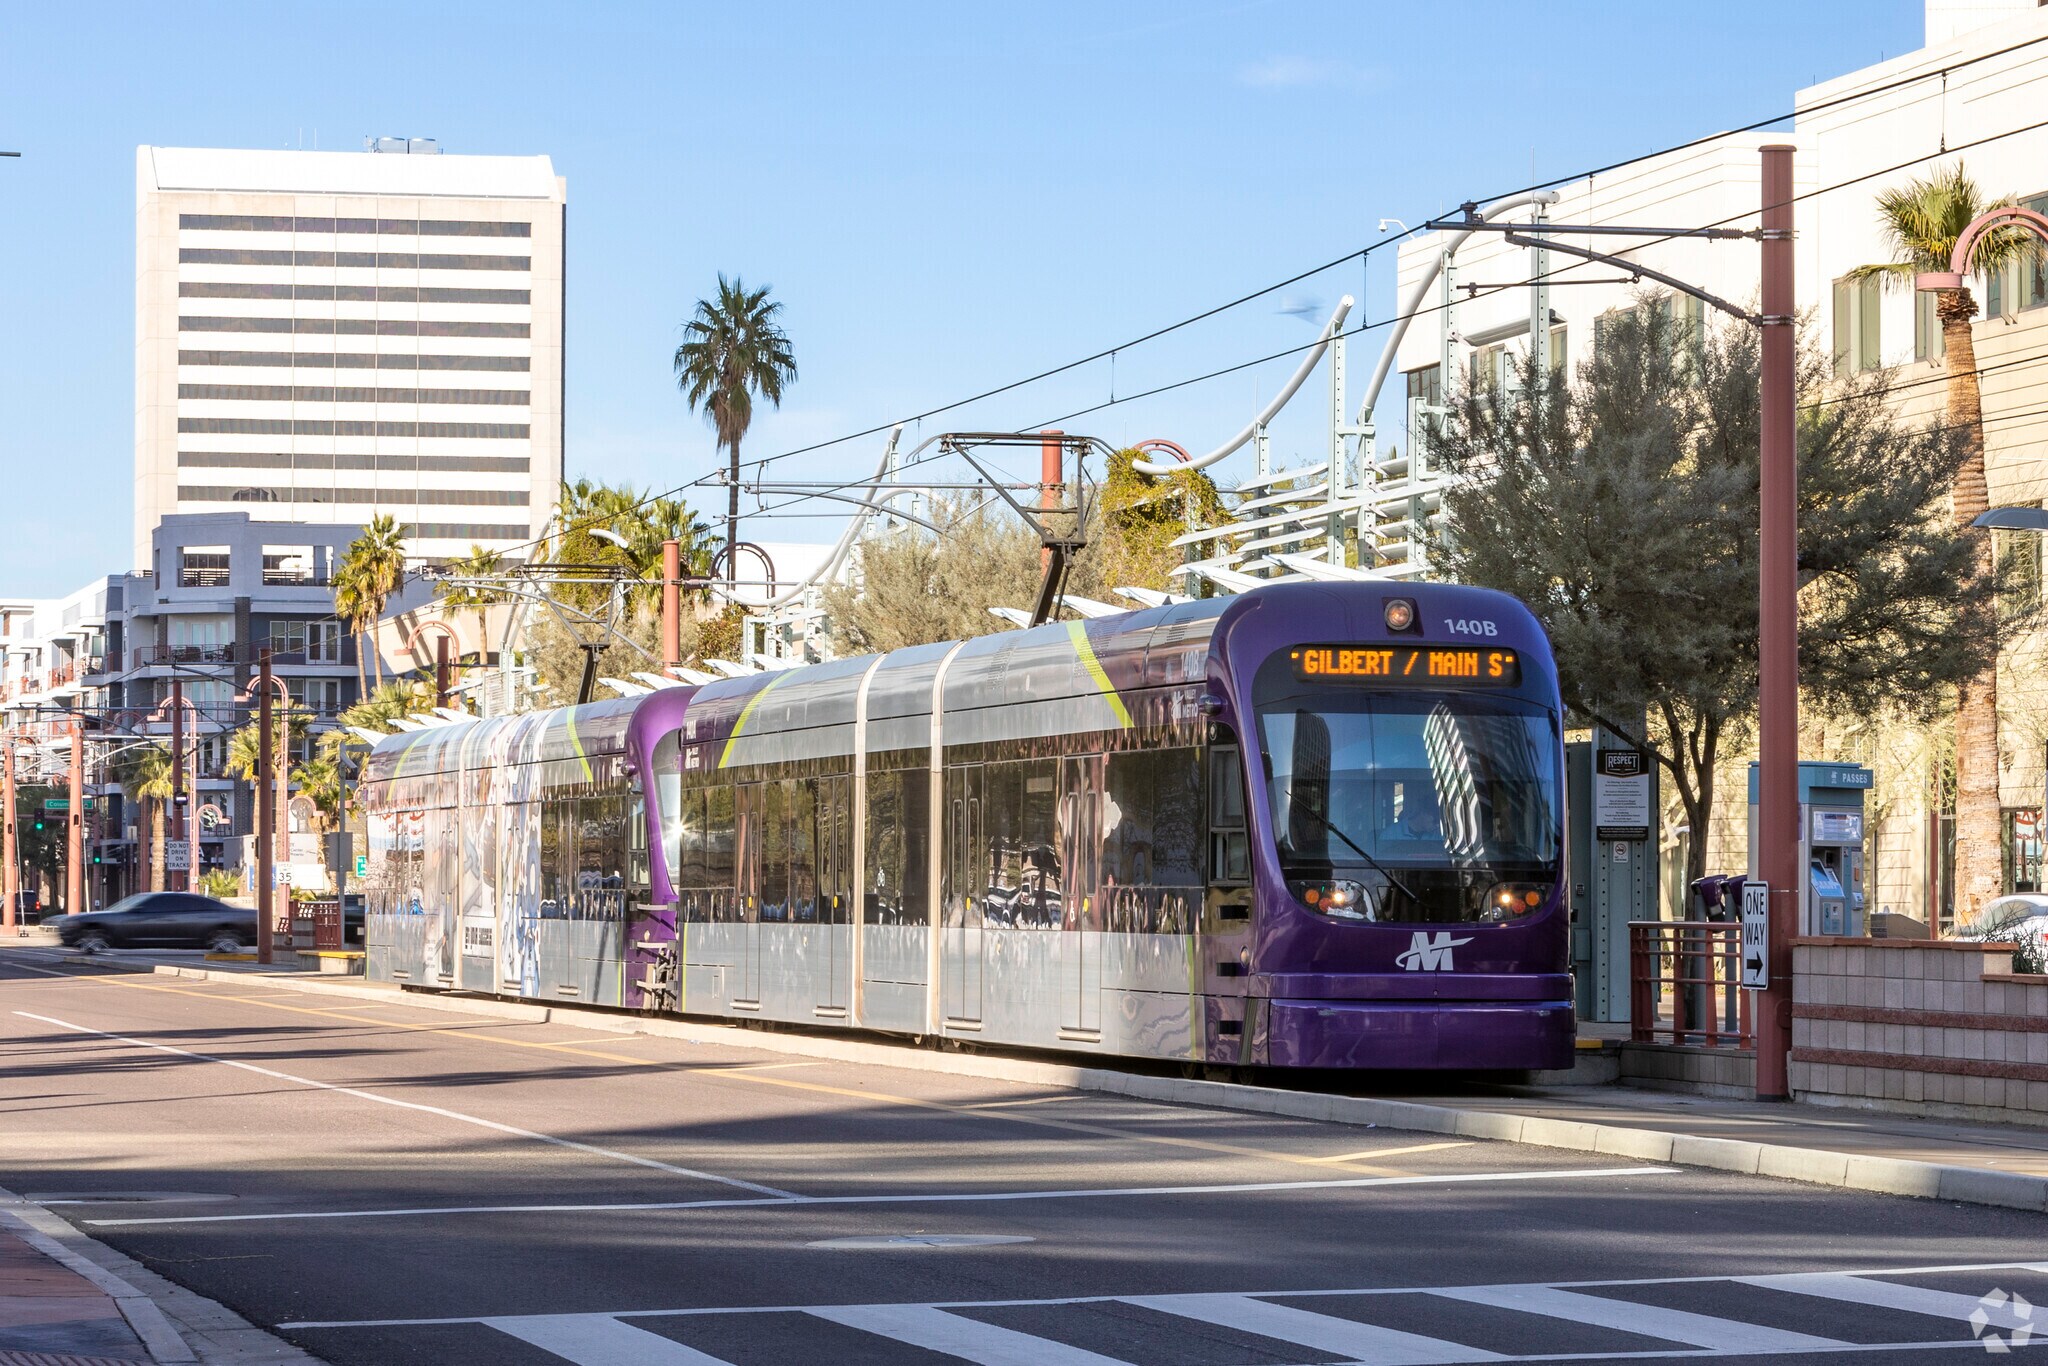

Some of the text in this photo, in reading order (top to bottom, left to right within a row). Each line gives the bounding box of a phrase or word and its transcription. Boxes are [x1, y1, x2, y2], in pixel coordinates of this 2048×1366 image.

[1444, 618, 1498, 637] 140B
[1181, 649, 1199, 678] 140B
[1304, 649, 1393, 675] GILBERT
[1403, 651, 1419, 676] /
[1428, 651, 1479, 677] MAIN
[1182, 702, 1199, 719] METRO
[1608, 755, 1637, 768] RESPECT
[1842, 773, 1868, 784] PASSES
[278, 872, 292, 882] 35
[1745, 892, 1764, 915] ONE
[1745, 922, 1766, 946] WAY
